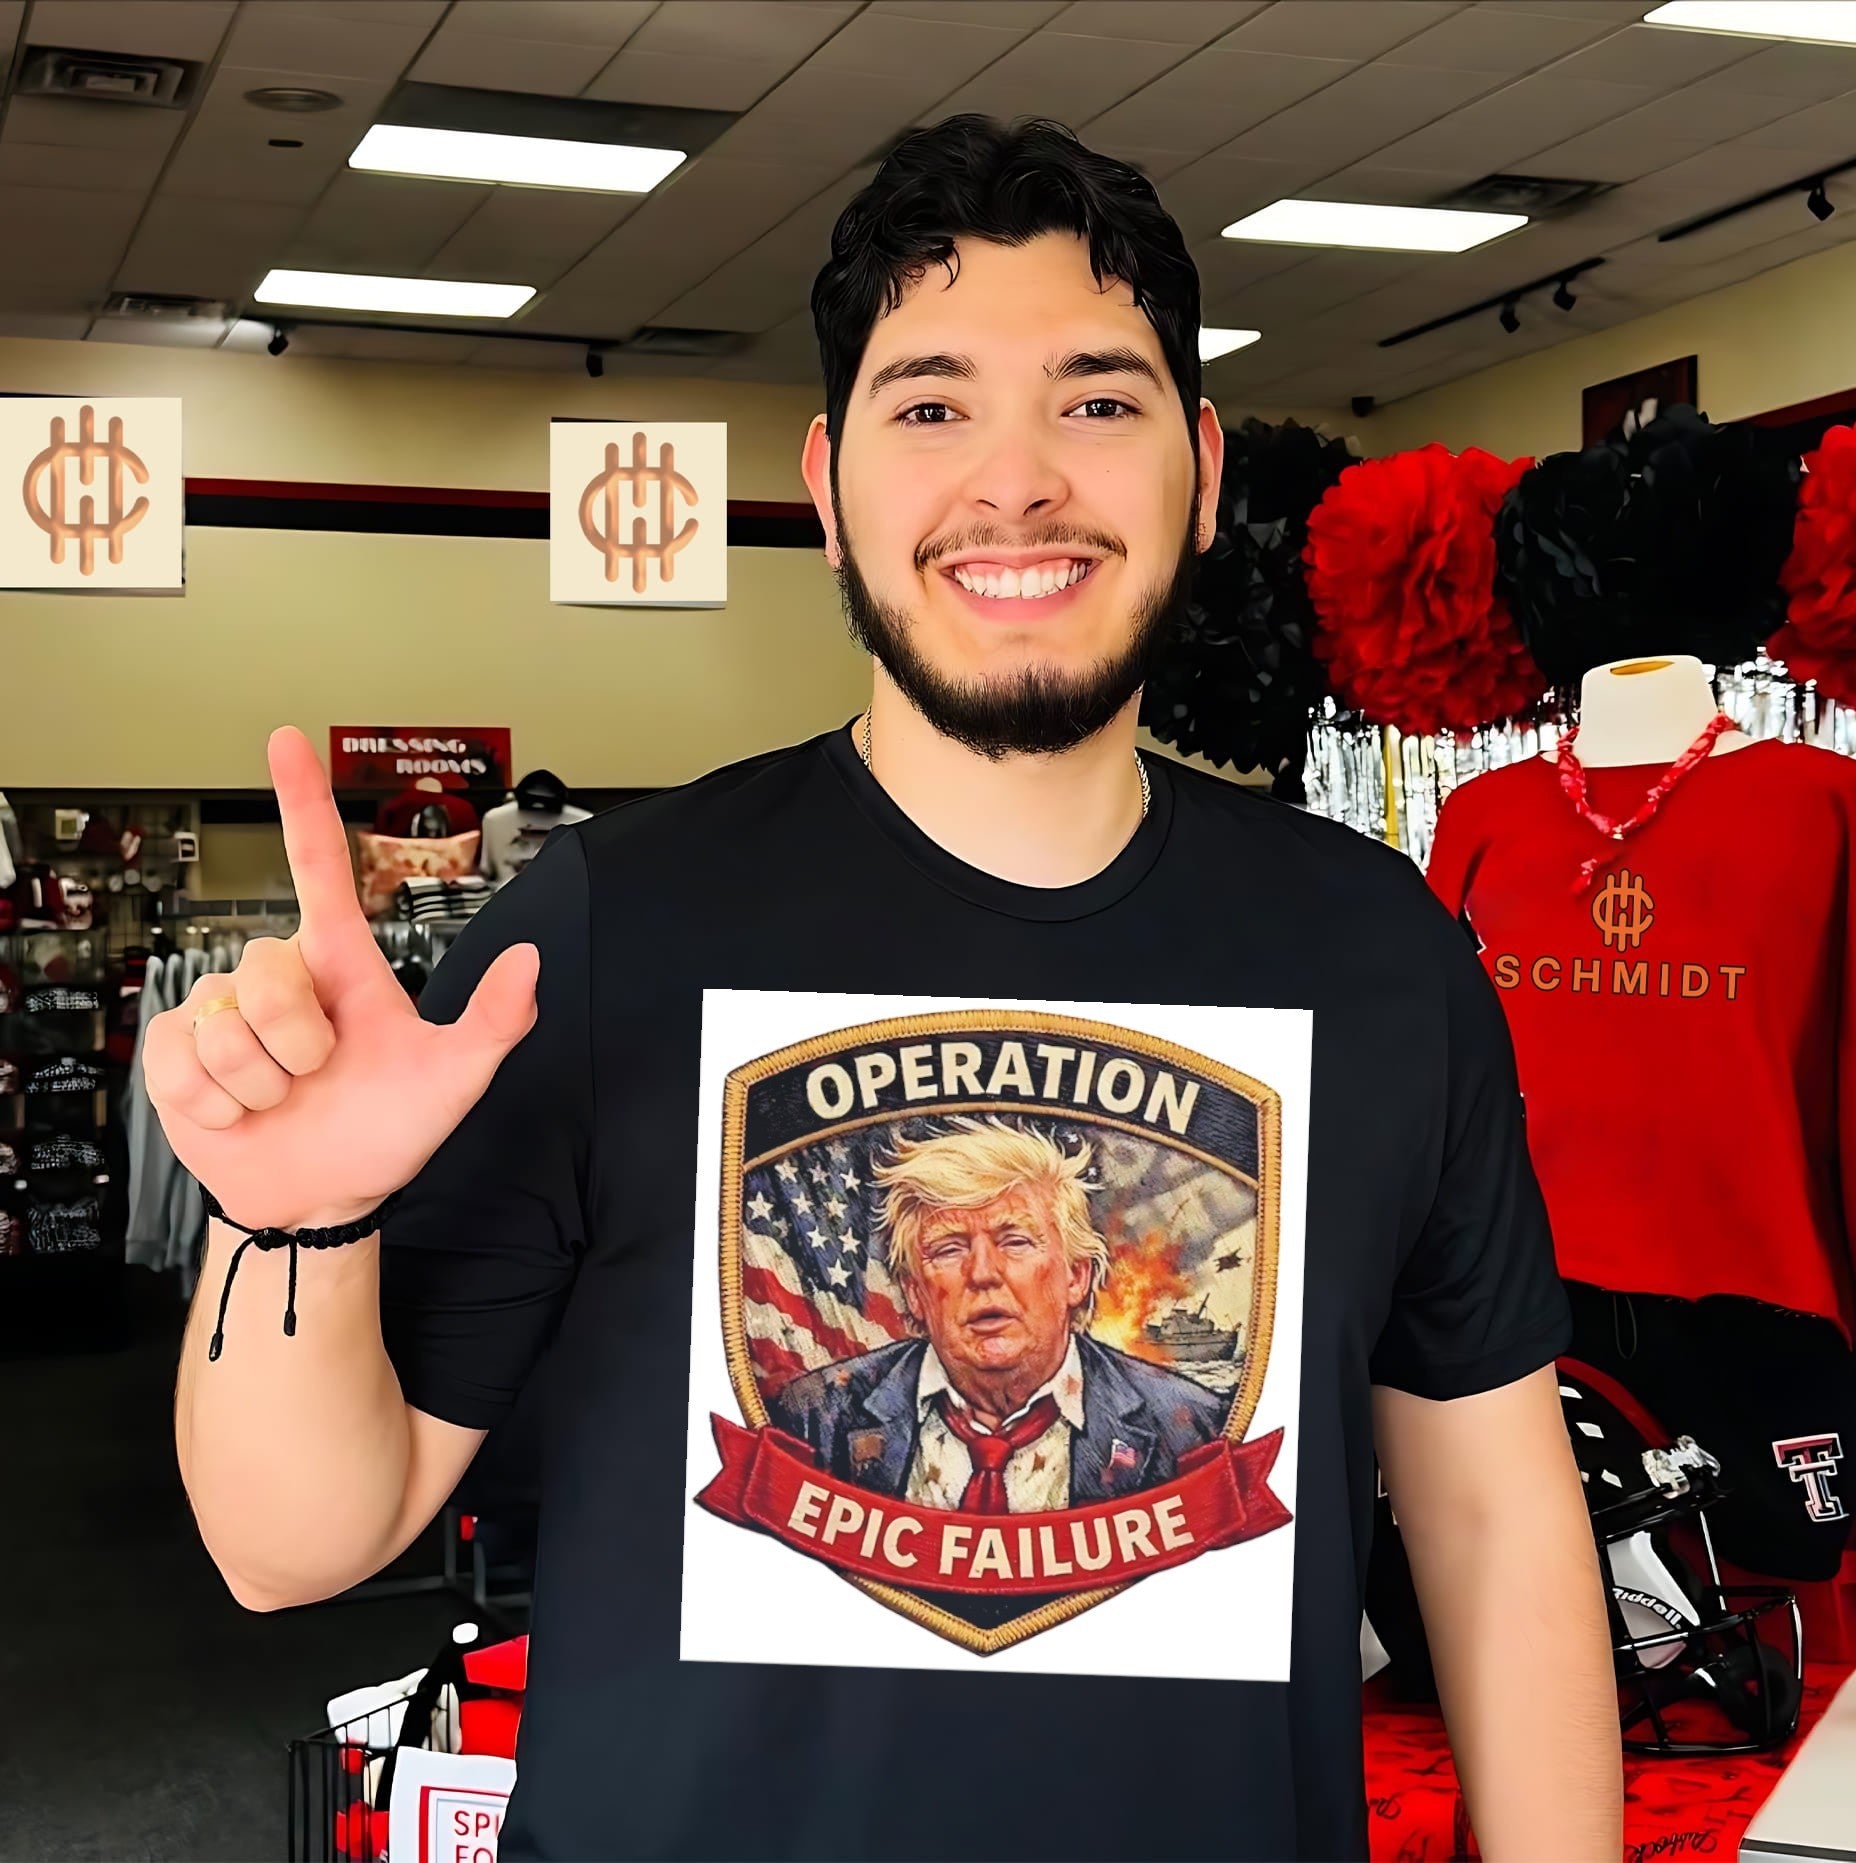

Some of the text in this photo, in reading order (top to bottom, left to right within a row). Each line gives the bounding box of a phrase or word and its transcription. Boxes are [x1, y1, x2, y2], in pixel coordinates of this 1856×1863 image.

[342, 737, 467, 754] DRESSING
[396, 758, 487, 775] ROOMS
[1494, 953, 1747, 1000] SCHMIDT
[806, 1041, 1200, 1135] OPERATION
[787, 1480, 1195, 1580] EPIC FAILURE
